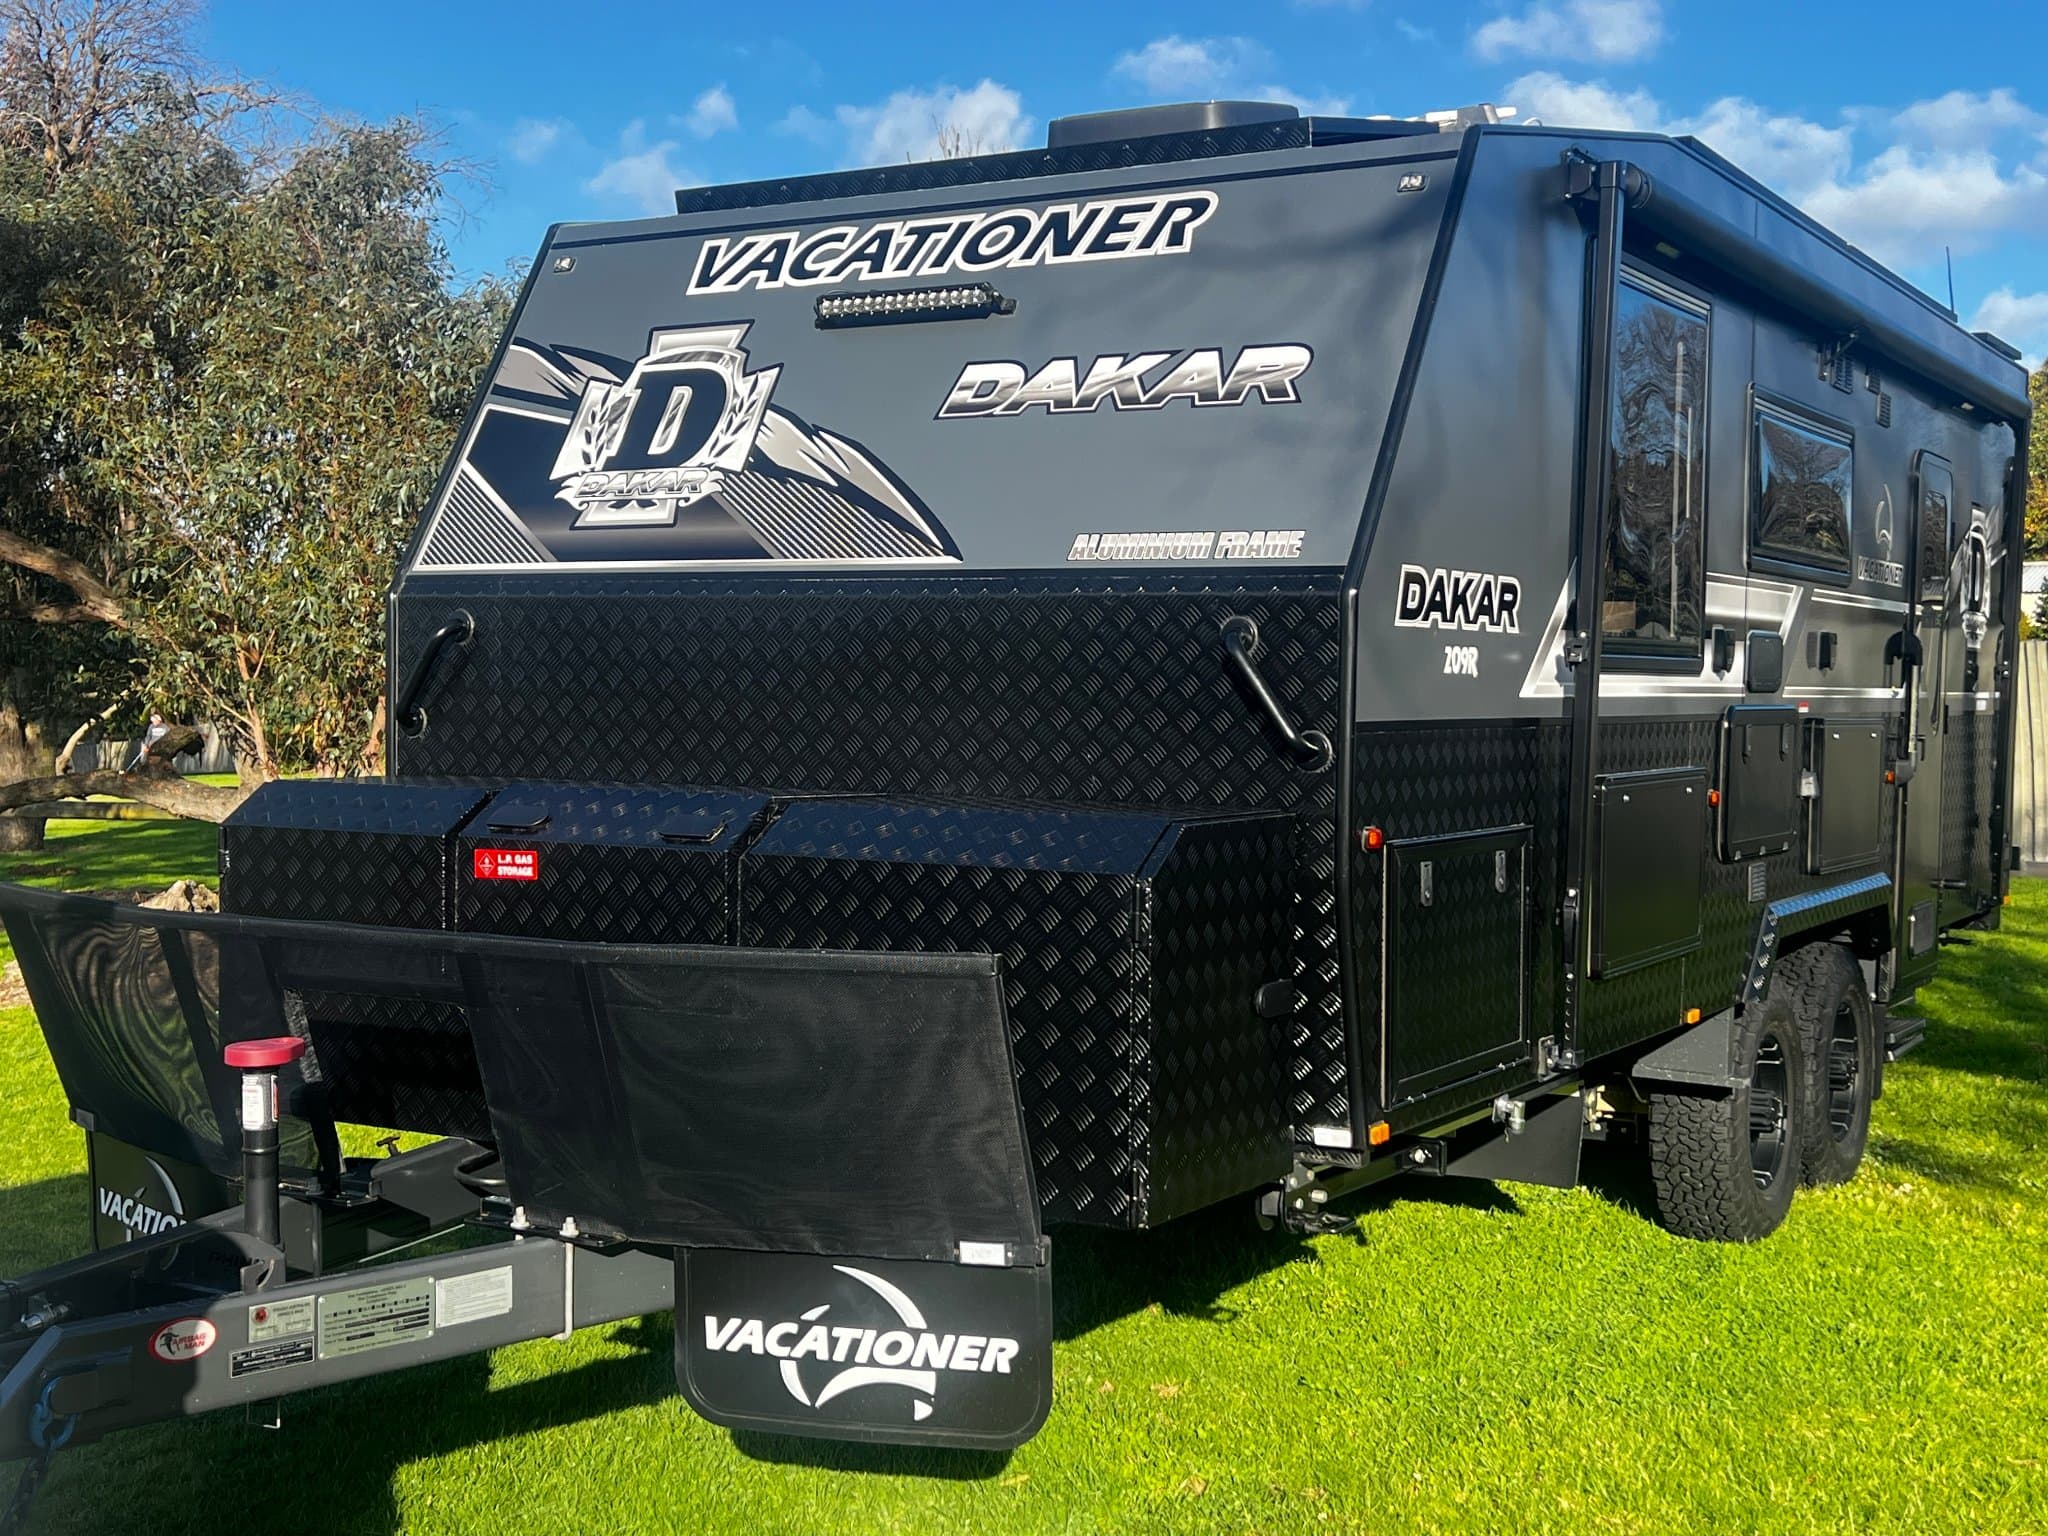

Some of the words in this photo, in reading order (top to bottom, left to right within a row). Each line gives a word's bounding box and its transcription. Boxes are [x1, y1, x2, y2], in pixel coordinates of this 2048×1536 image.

[686, 190, 1218, 295] VACATIONER
[933, 342, 1313, 420] DAKAR
[600, 366, 730, 472] D
[574, 470, 710, 498] DAKAR
[1067, 533, 1215, 561] ALUMINIUM
[1213, 530, 1306, 559] FRAME
[1394, 563, 1521, 634] DAKAR
[1443, 645, 1479, 678] 209R
[497, 866, 533, 877] STORAGE
[514, 854, 533, 865] GAS
[100, 1186, 187, 1235] VACATIO
[173, 1333, 206, 1346] AIRBAG
[184, 1341, 205, 1350] MAN
[704, 1315, 1019, 1374] VACATIONER
